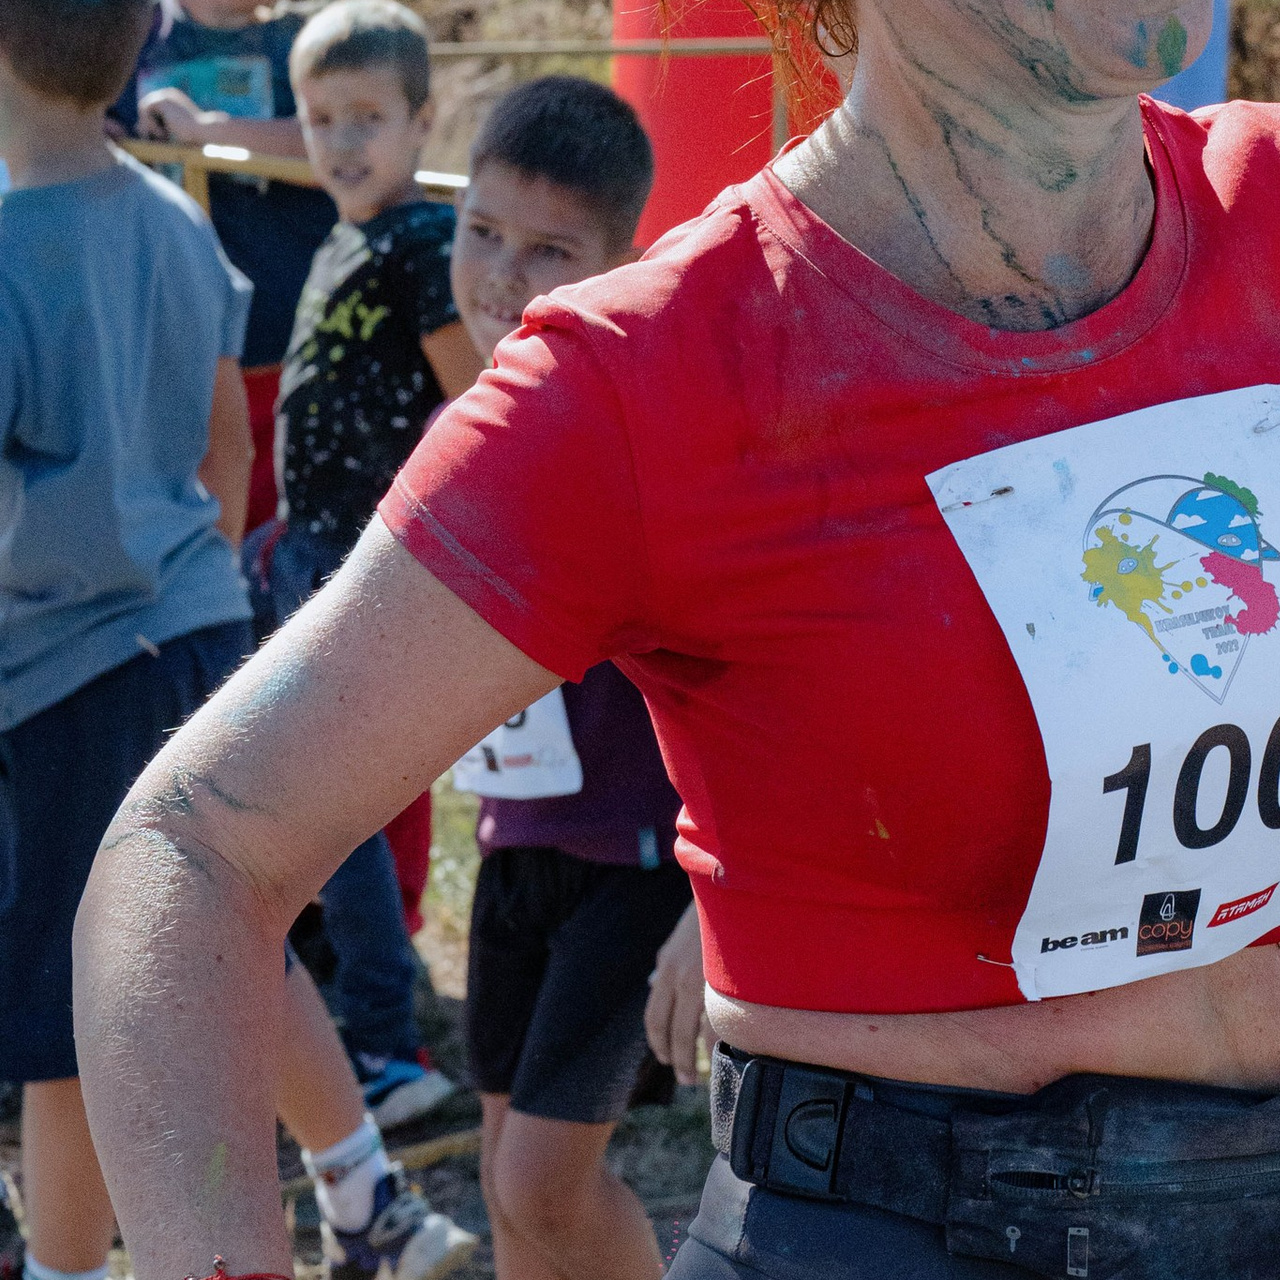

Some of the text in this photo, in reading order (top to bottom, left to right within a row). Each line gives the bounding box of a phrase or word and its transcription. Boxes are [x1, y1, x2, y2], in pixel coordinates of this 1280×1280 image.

[1202, 623, 1236, 640] TRAIL
[1216, 639, 1239, 655] 2023
[1140, 920, 1193, 941] copy
